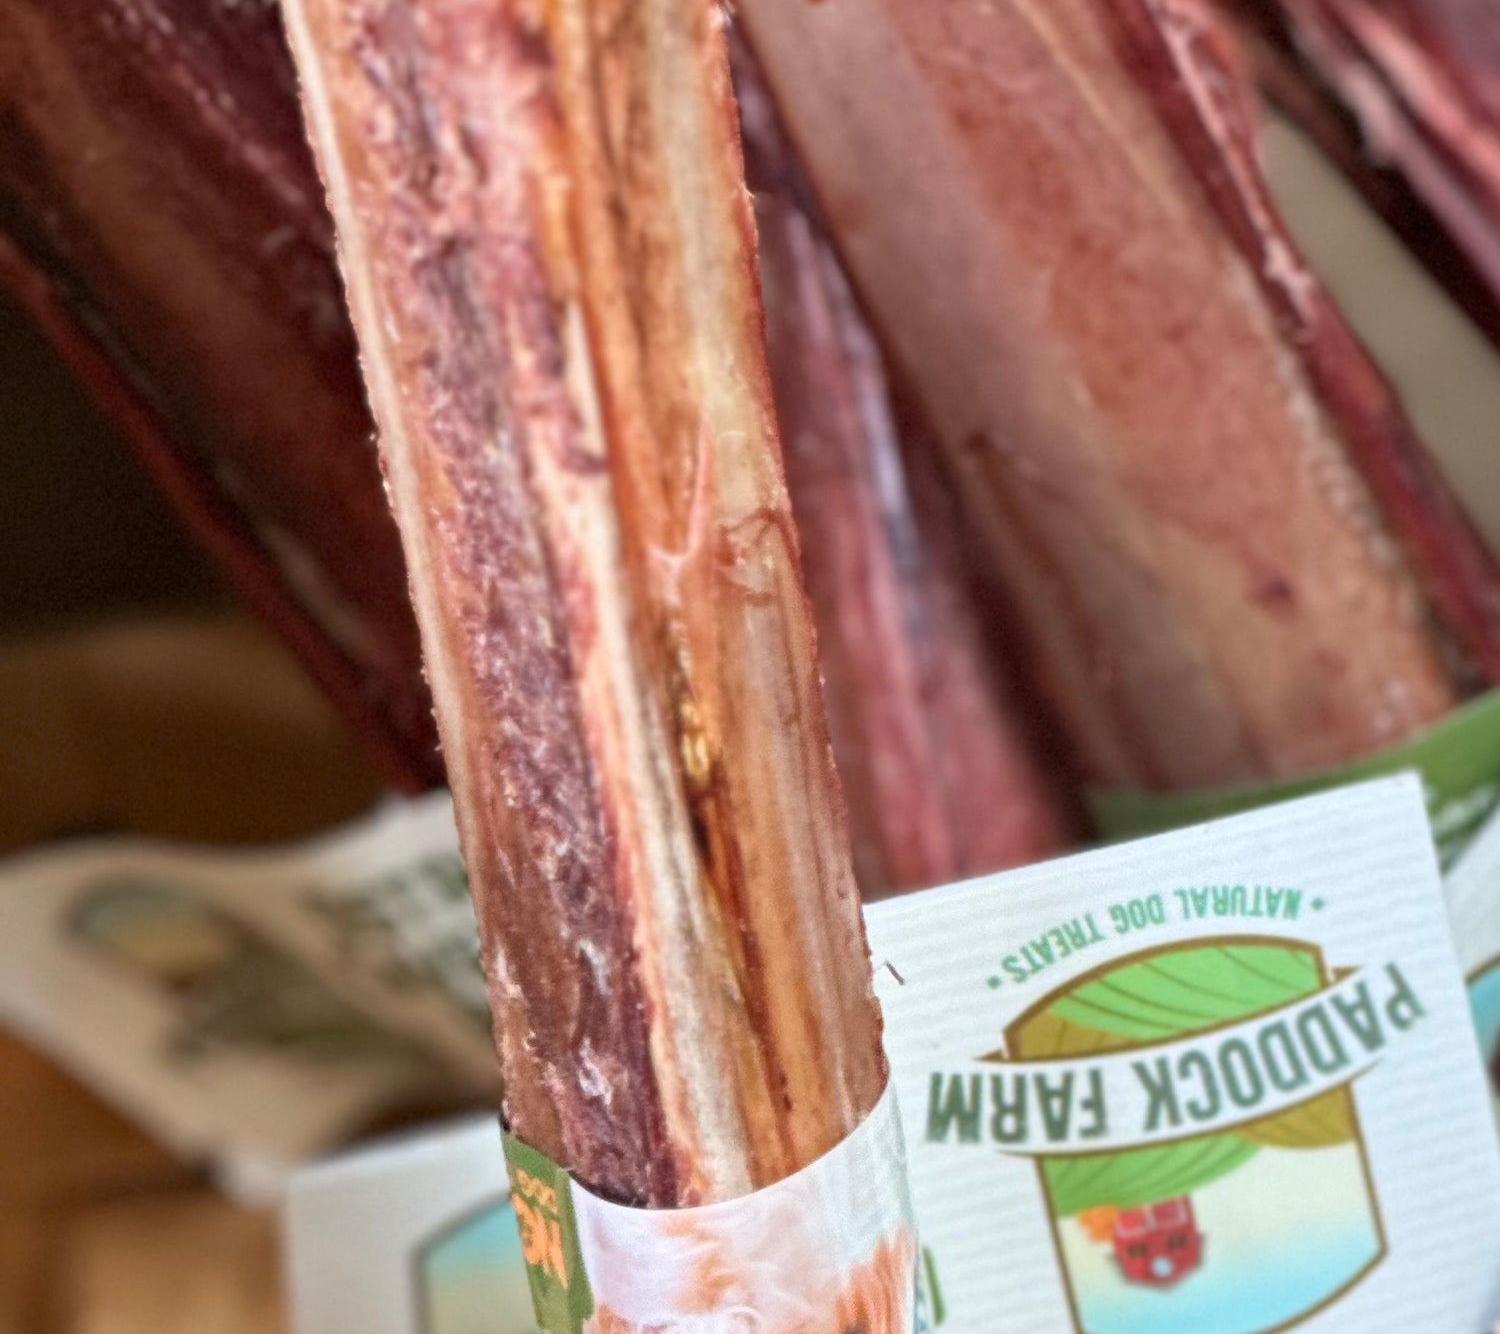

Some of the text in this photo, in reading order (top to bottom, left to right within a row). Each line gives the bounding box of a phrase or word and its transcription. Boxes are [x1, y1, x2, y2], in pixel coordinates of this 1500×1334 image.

[1002, 884, 1301, 984] NATURAL DOG TREATS
[926, 962, 1427, 1144] PADDOCK FARM
